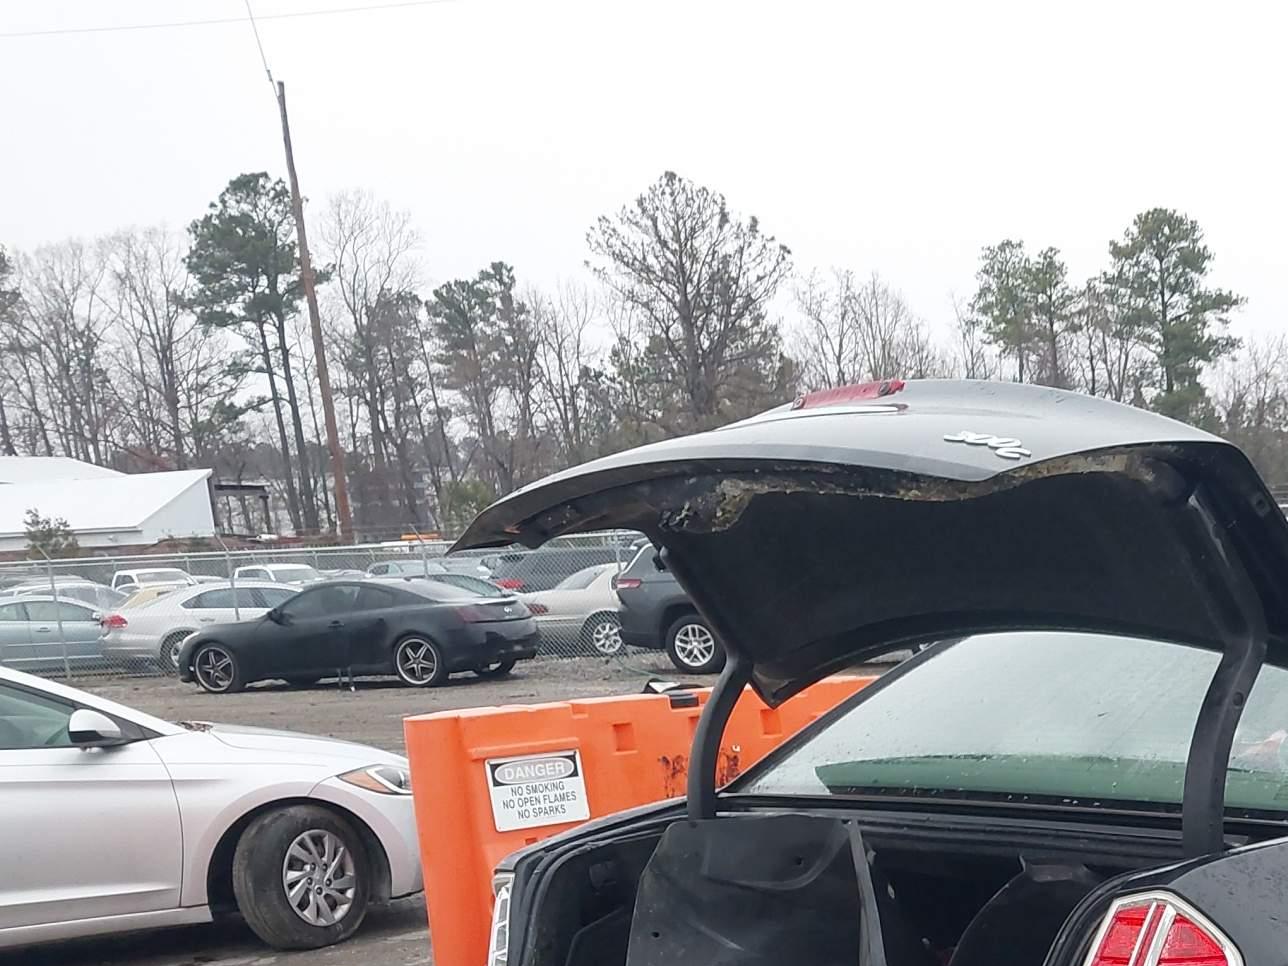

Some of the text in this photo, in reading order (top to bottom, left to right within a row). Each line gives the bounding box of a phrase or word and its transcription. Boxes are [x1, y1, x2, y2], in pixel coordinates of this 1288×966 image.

[504, 762, 565, 780] DANGER
[511, 781, 565, 797] NO SMOKING
[503, 791, 577, 809] NO OPEN FLAMES
[518, 804, 567, 819] NO SPARKS
